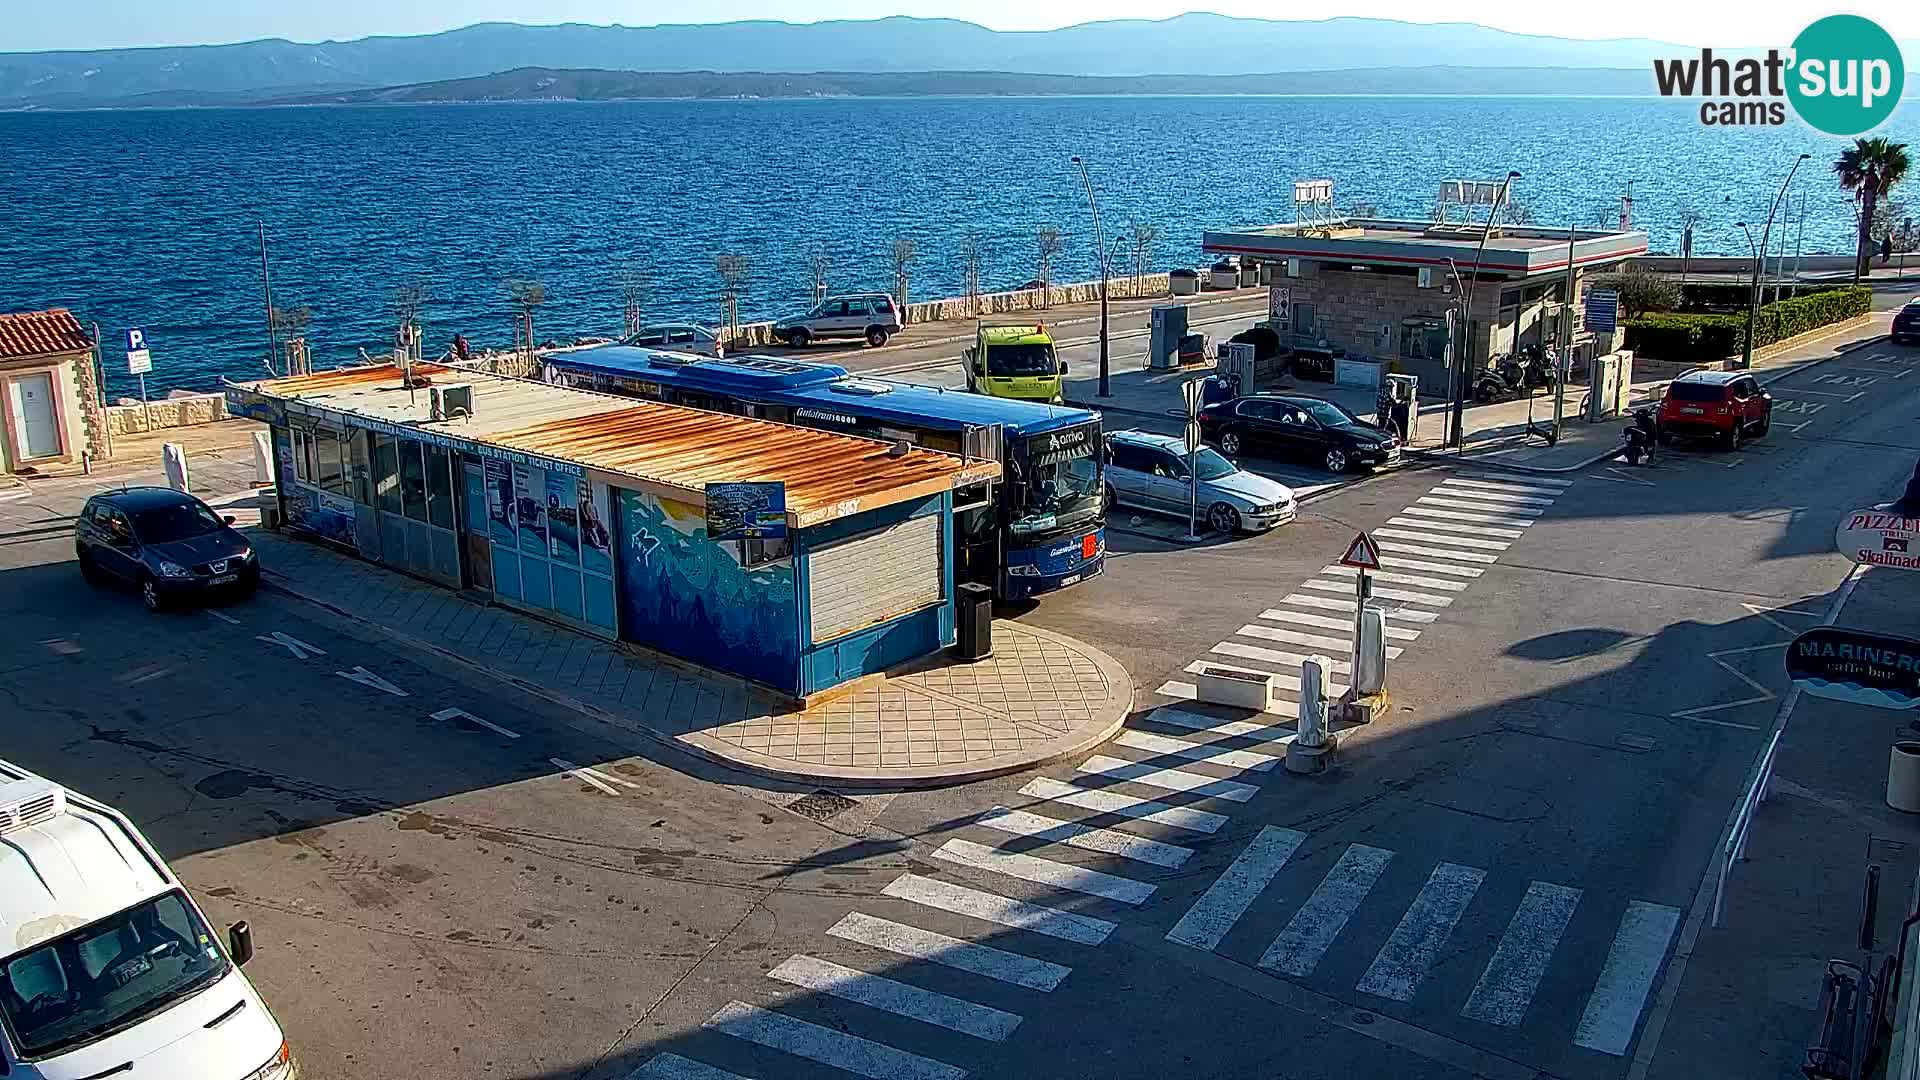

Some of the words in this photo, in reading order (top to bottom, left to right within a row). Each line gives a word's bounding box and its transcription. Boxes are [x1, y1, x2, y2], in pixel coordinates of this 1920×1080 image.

[129, 330, 143, 349] P
[1060, 431, 1084, 445] arriva
[478, 445, 492, 457] BUS
[493, 448, 526, 465] STATION
[527, 457, 553, 471] TICKET
[554, 462, 582, 477] OFFICE
[1868, 664, 1896, 680] bar
